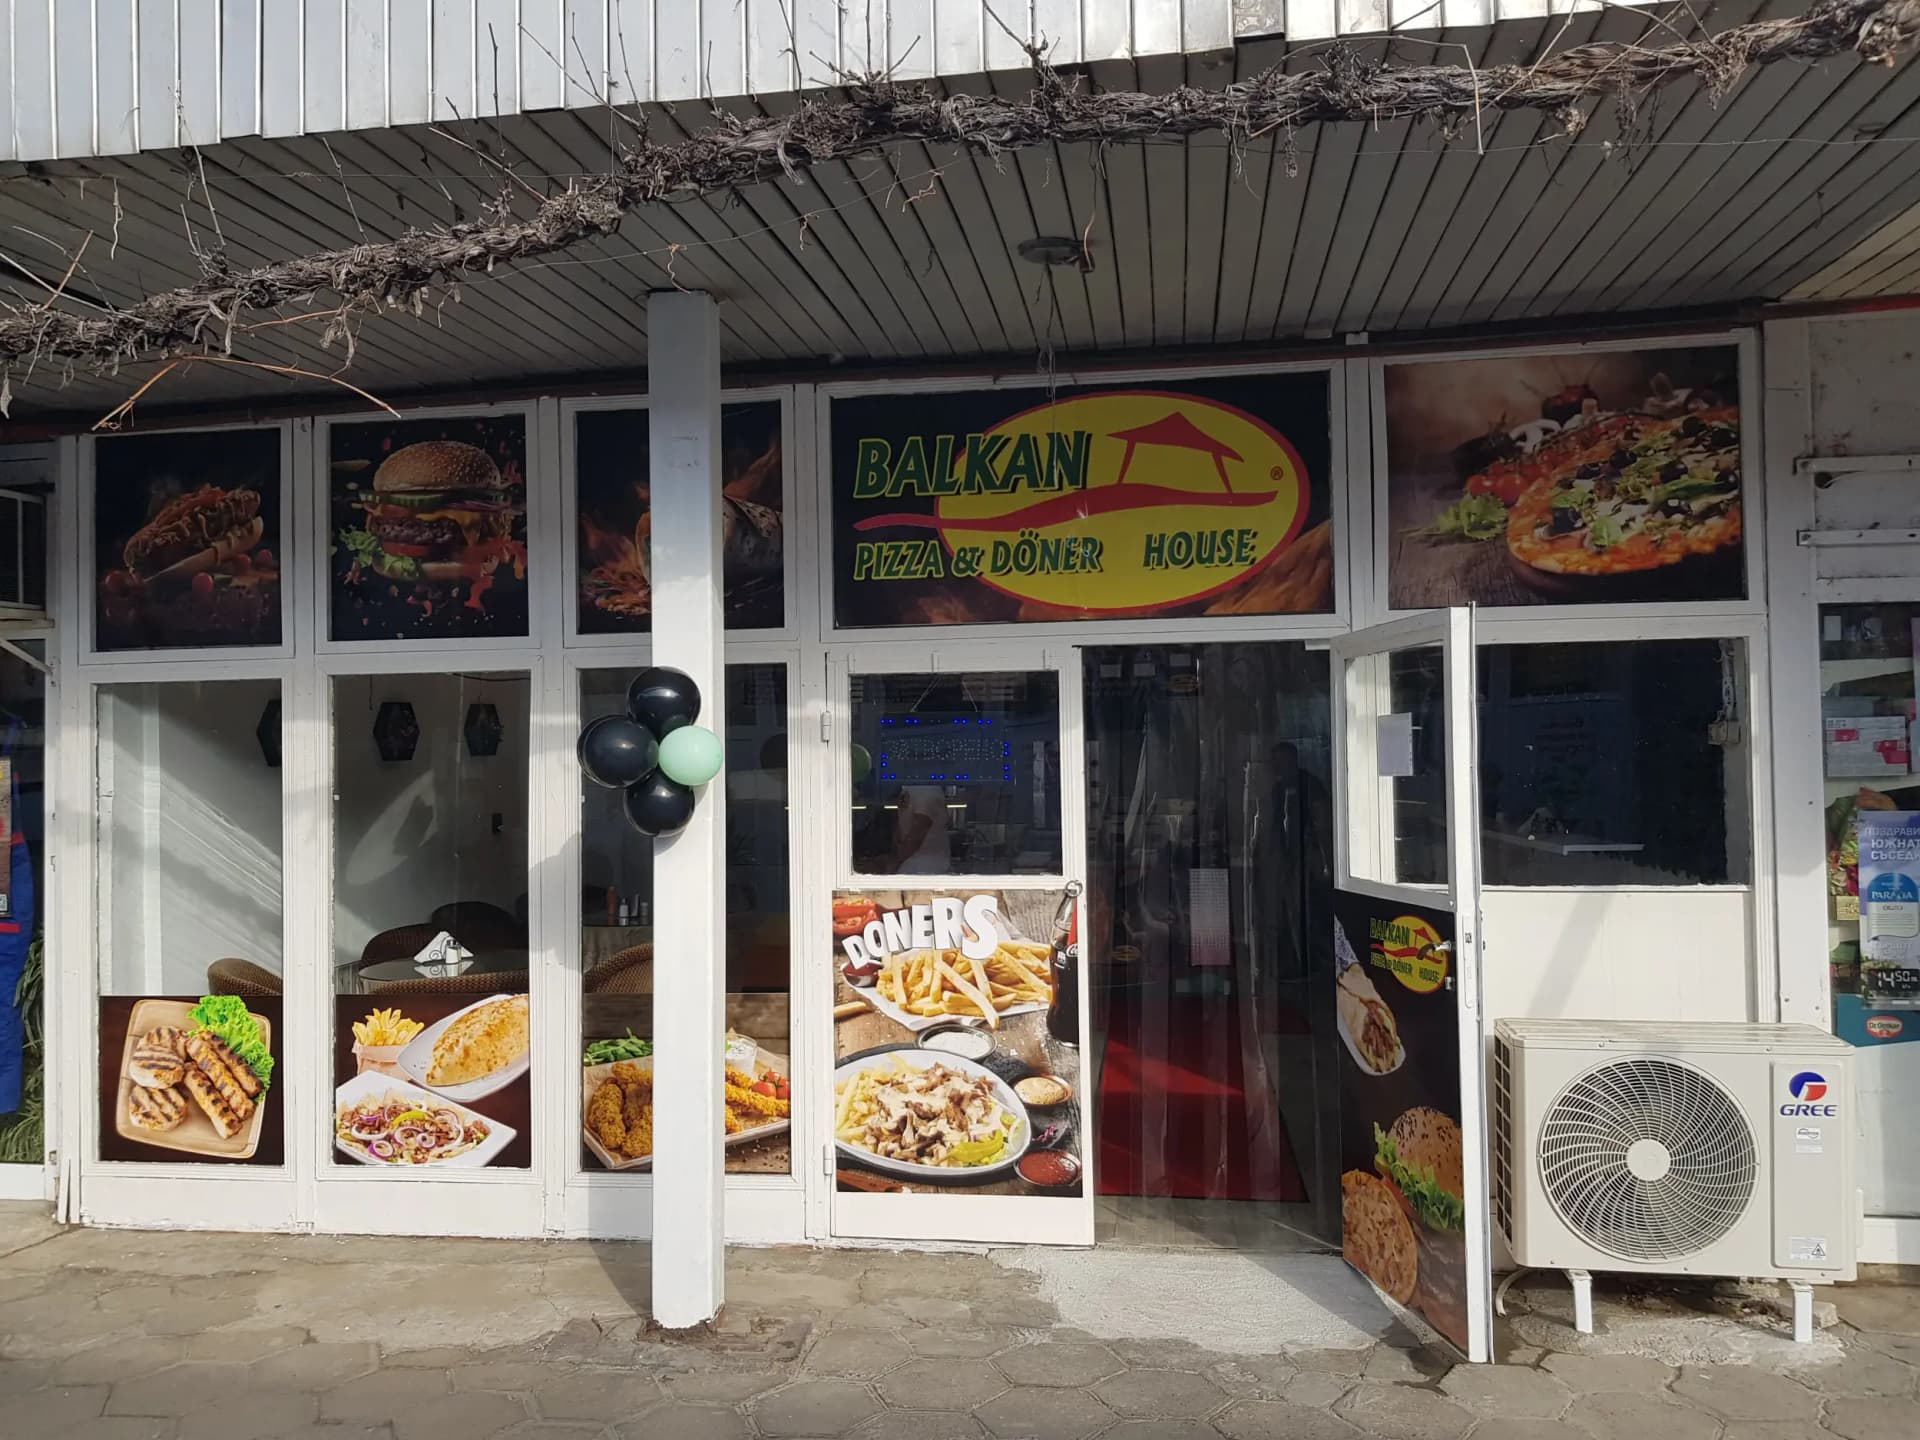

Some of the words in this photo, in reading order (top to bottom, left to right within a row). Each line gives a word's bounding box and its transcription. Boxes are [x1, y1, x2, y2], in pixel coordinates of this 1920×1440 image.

[852, 432, 1091, 498] BALKAN
[853, 540, 945, 581] PIZZA
[953, 545, 983, 576] &
[990, 527, 1102, 575] DÖNER
[1143, 527, 1258, 569] HOUSE
[841, 895, 998, 969] DONERS
[1369, 917, 1410, 946] BALKAN
[1780, 1103, 1838, 1117] GREE
